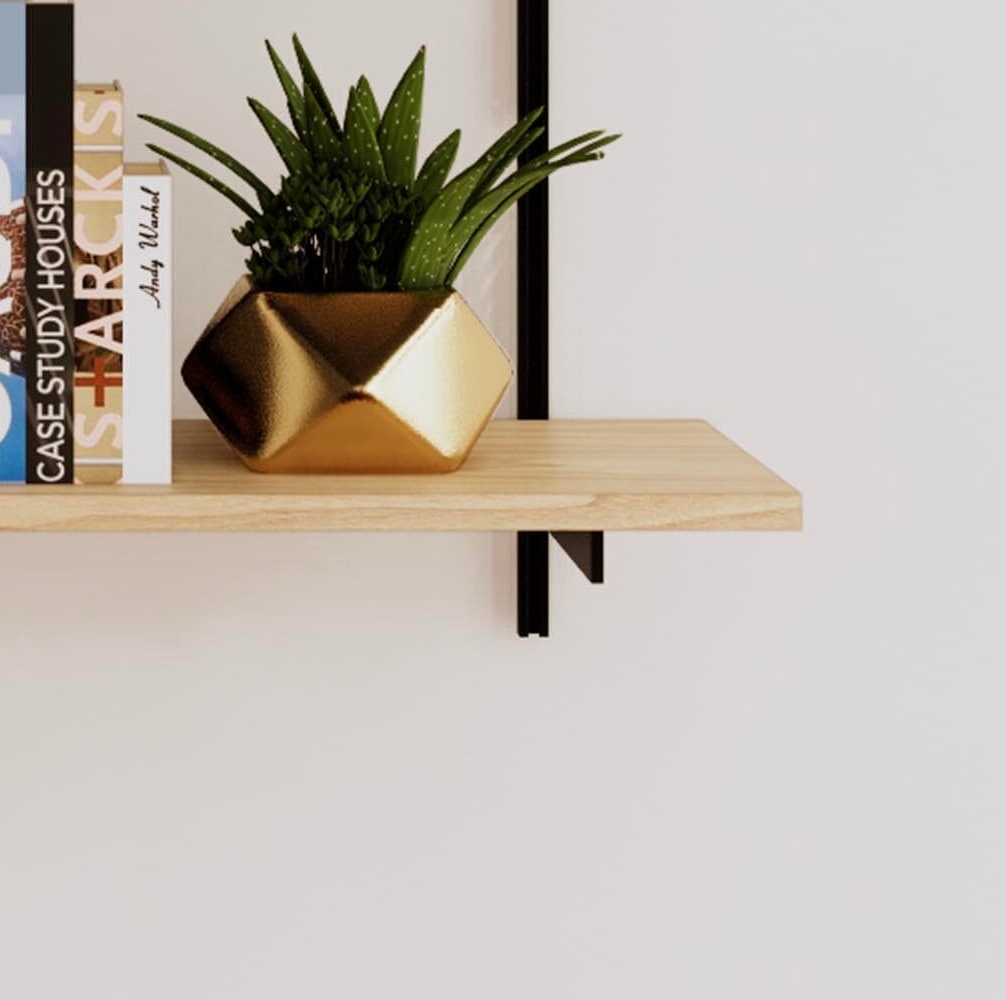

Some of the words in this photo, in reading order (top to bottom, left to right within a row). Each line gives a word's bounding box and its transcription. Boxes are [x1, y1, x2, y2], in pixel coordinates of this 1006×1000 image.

[36, 169, 65, 284] HOUSES
[137, 186, 161, 250] Warhol
[138, 260, 165, 309] Andy
[36, 297, 65, 395] STUDY
[36, 402, 65, 483] CASE
